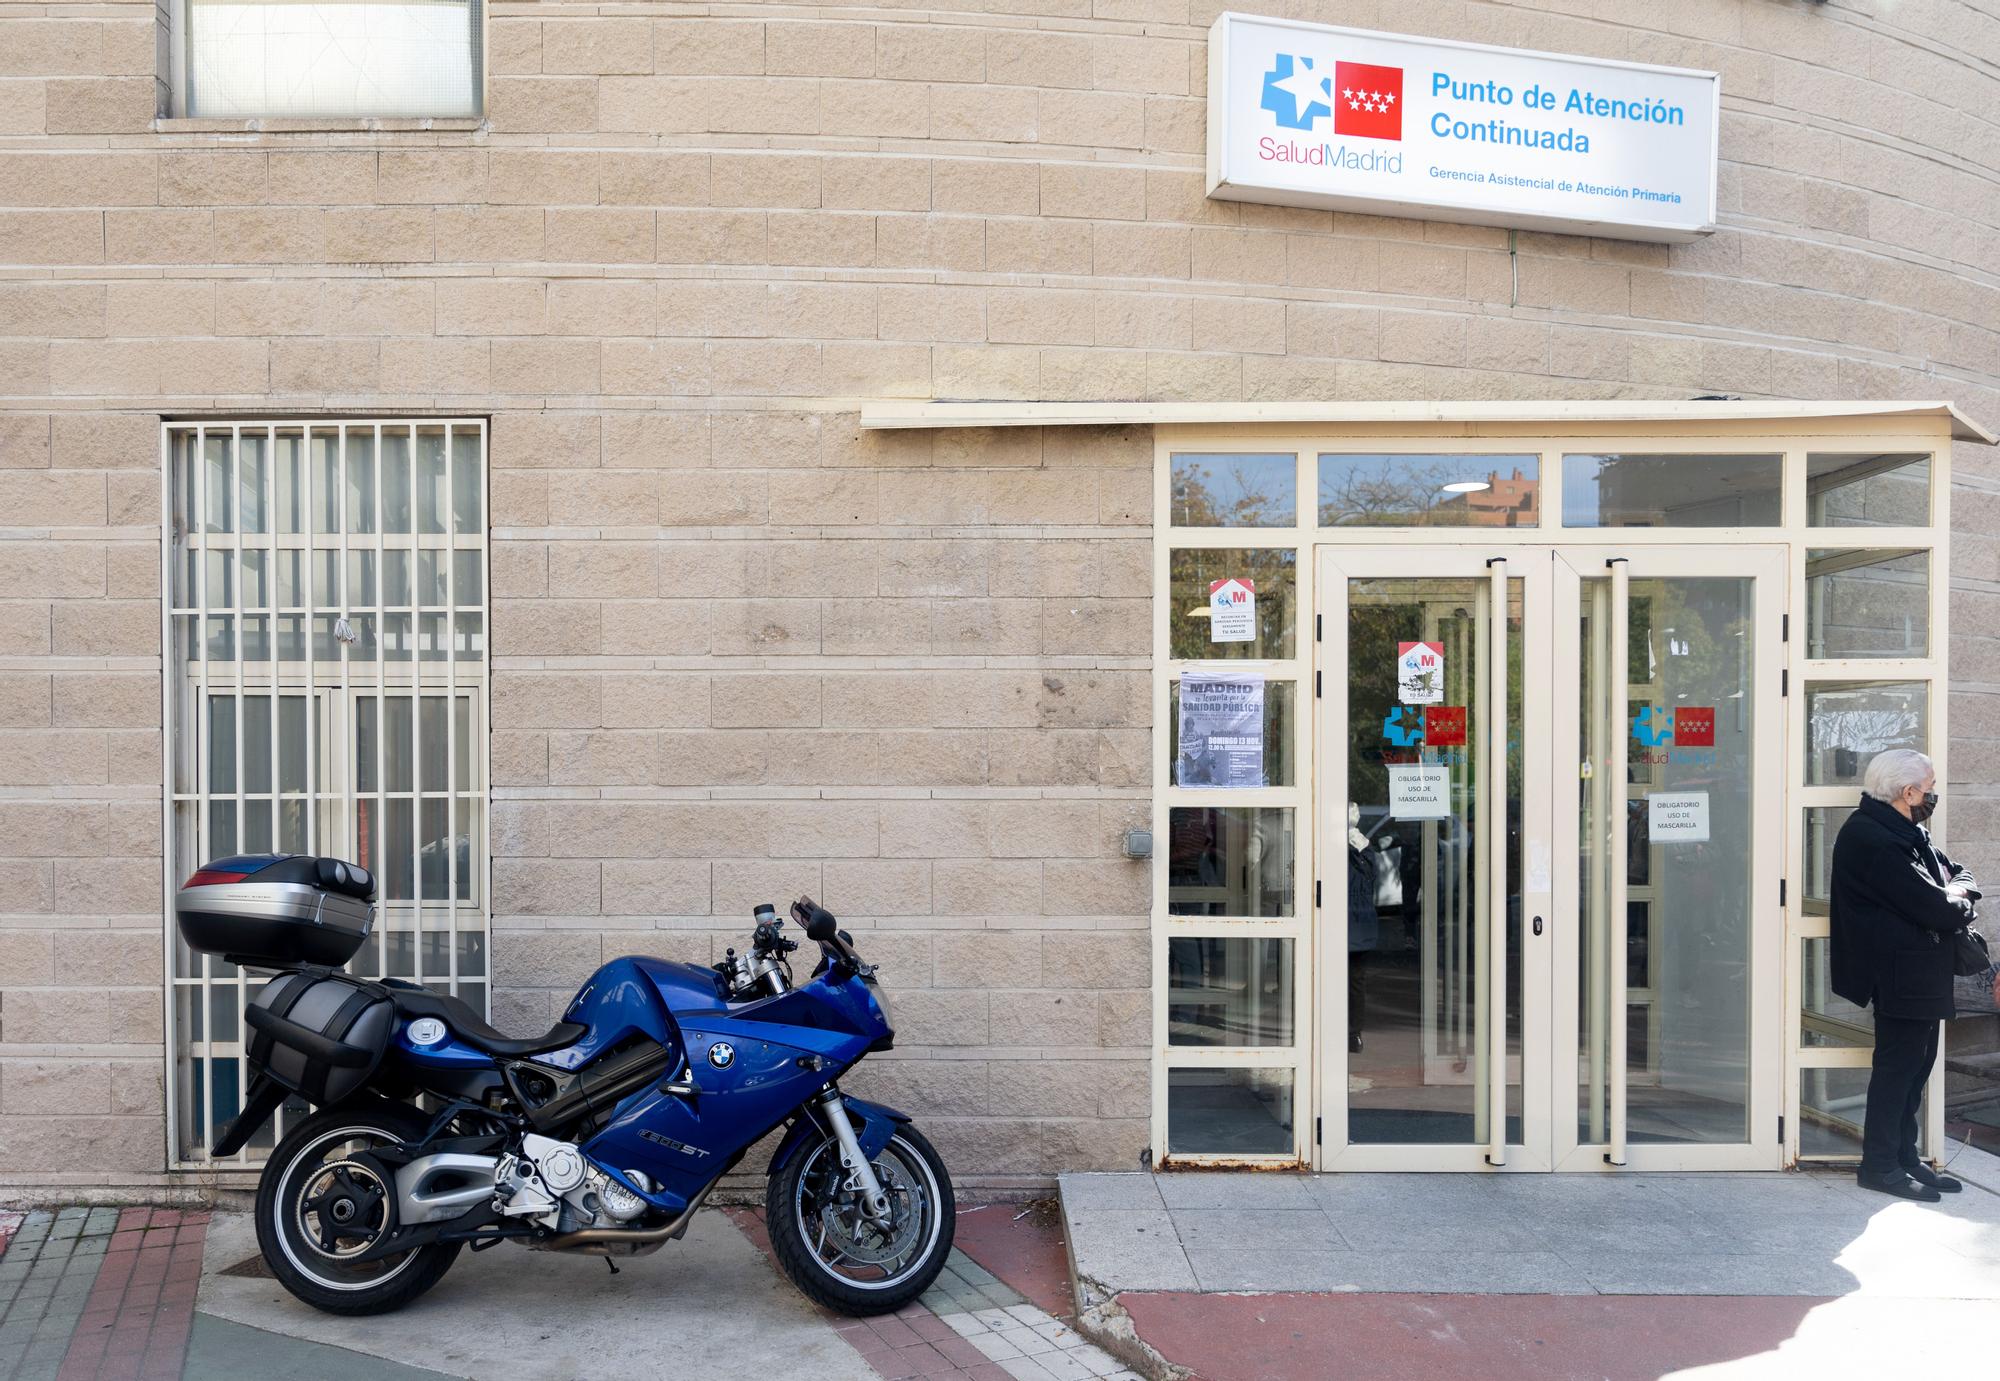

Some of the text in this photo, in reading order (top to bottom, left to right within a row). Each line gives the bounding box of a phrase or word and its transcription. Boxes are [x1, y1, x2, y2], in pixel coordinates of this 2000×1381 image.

[1431, 72, 1684, 126] Punto de Atención
[1431, 112, 1590, 153] Continuada
[1259, 136, 1402, 174] SaludMadrid
[1429, 166, 1681, 204] Gerencia Asistencial de Atención Primaria
[1421, 655, 1434, 666] M
[1189, 683, 1254, 694] MADRID
[1182, 702, 1221, 712] SANIDAD
[1208, 736, 1238, 745] DOMINGO
[1238, 736, 1246, 745] 13
